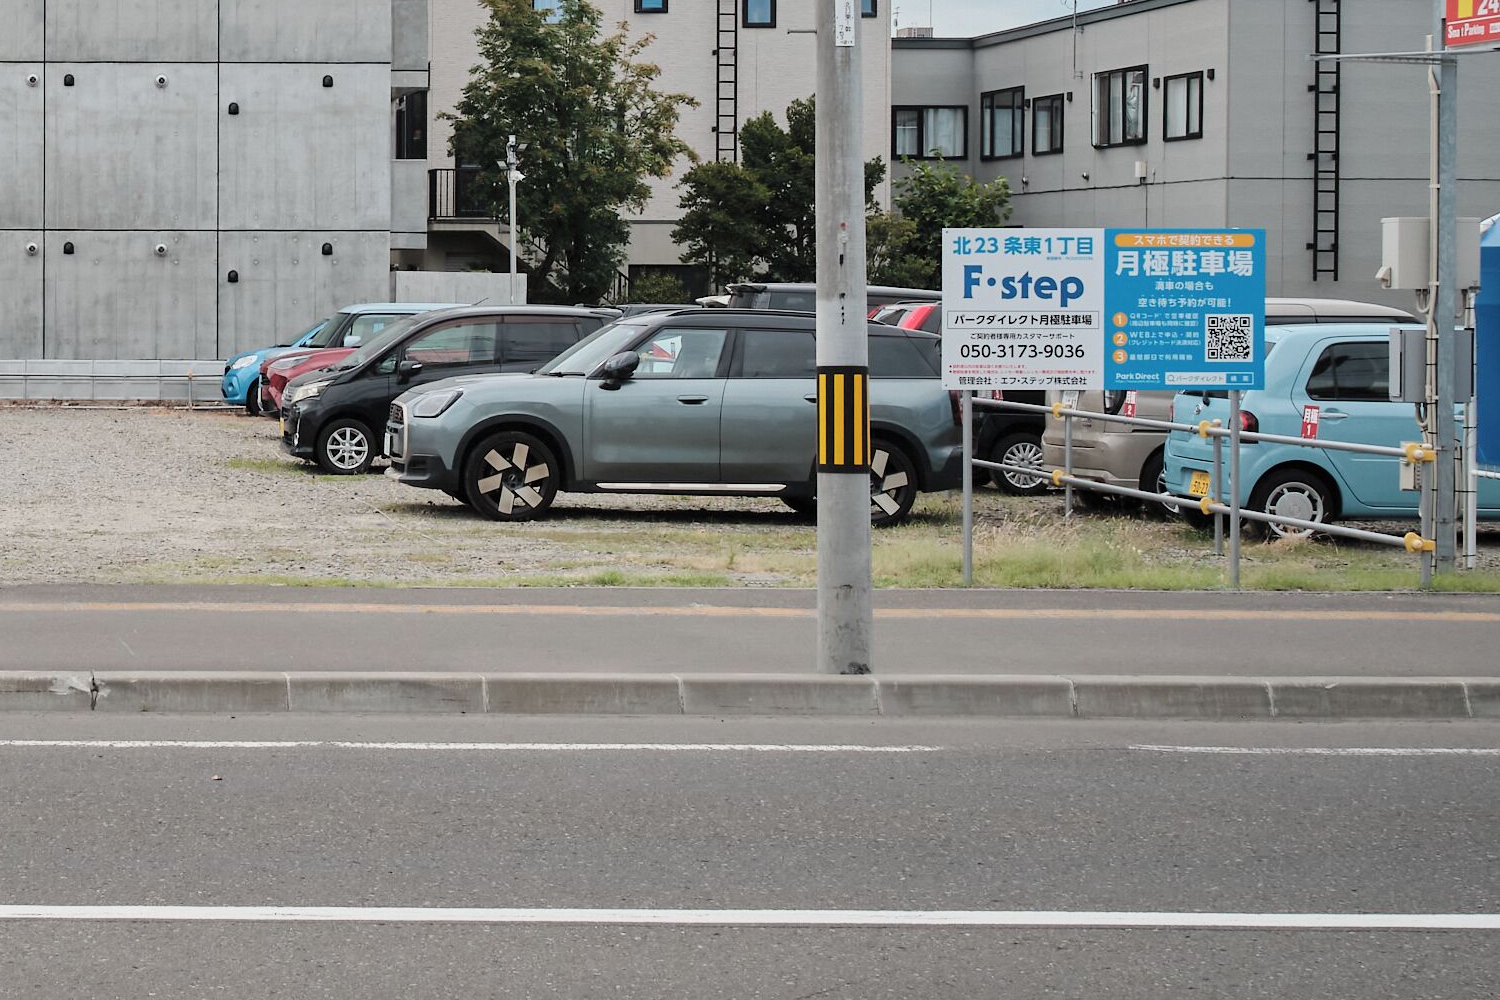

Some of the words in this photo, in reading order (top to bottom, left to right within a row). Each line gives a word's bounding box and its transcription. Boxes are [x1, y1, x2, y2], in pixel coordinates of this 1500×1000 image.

[1448, 25, 1464, 38] Smat
[1134, 235, 1235, 245] スマホで契約できる
[1116, 250, 1253, 276] 月極駐車場
[955, 315, 1092, 325] パークダイレクト月極駐車場
[961, 345, 1085, 358] 050-3173-9036
